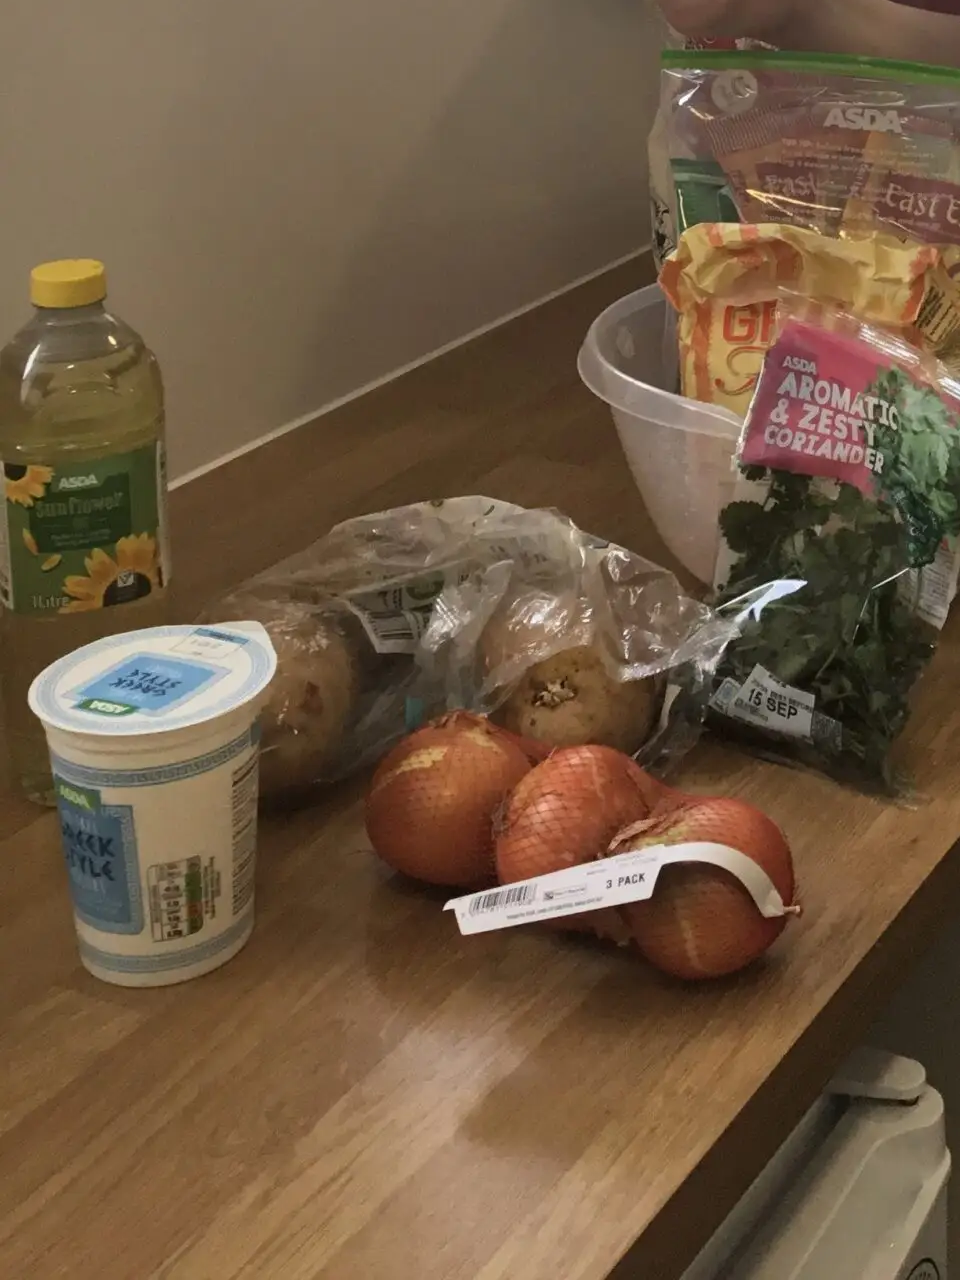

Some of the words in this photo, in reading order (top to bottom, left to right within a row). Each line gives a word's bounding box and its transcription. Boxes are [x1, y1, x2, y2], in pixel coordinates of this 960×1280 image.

[823, 107, 903, 133] ASDA
[885, 181, 941, 219] East
[782, 355, 816, 375] ASDA
[777, 372, 899, 431] AROMATIC
[769, 398, 789, 424] &
[801, 404, 876, 444] ZESTY
[764, 424, 884, 475] CORIANDER
[58, 474, 99, 490] ASDA
[109, 677, 166, 696] GREEK
[126, 669, 182, 689] STYLE
[89, 700, 130, 713] ASDA
[748, 688, 762, 707] 15
[766, 697, 798, 720] SEP
[606, 879, 613, 890] 3
[617, 872, 646, 888] PACK
